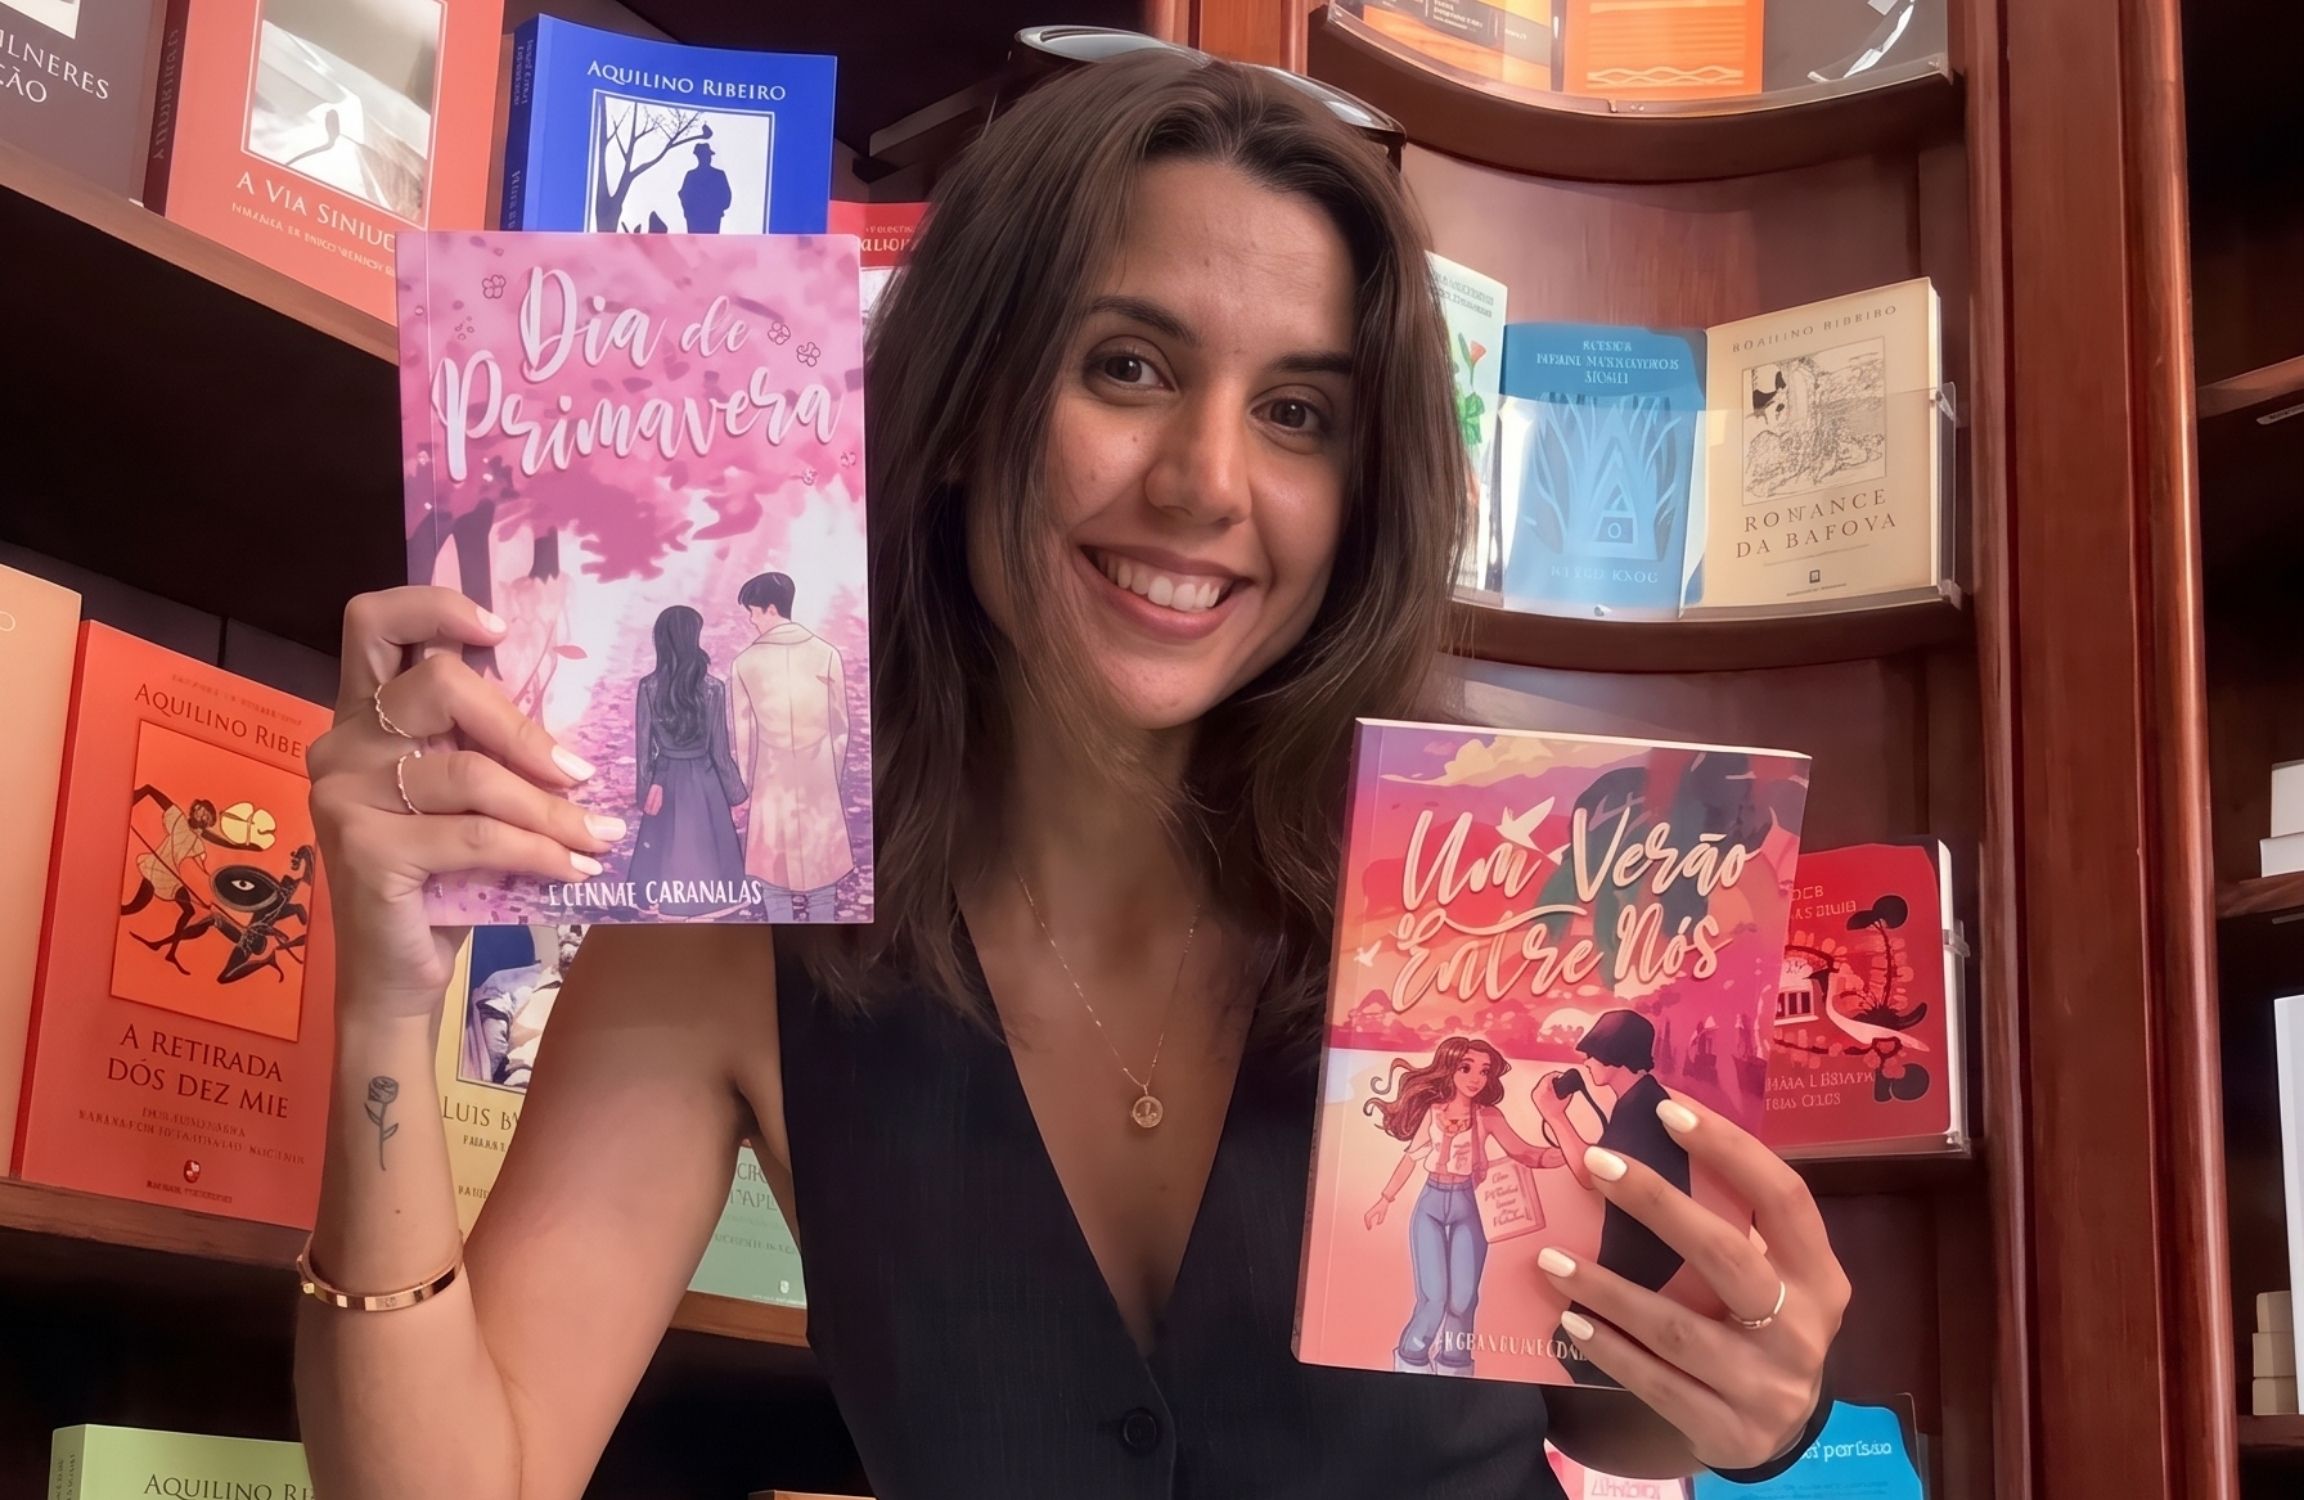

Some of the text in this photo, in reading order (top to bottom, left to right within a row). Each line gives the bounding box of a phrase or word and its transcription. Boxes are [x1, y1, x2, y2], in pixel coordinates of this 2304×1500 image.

[587, 60, 786, 101] AQUILINO RIBEIRO
[236, 171, 255, 195] A
[265, 179, 307, 216] VIA
[520, 266, 751, 382] Dia de
[432, 350, 843, 481] Primavera
[1736, 513, 1896, 558] DA BAFOVA
[135, 682, 248, 739] AQUILINO
[1402, 806, 1761, 911] Um Verão
[645, 880, 763, 905] CARANALAS
[1392, 903, 1732, 1013] Entre Nós
[120, 1023, 283, 1082] A RETIRADA
[107, 1058, 289, 1119] DÓS DEZ MIE
[443, 1095, 490, 1127] LUIS
[143, 1474, 272, 1500] AQUILINO
